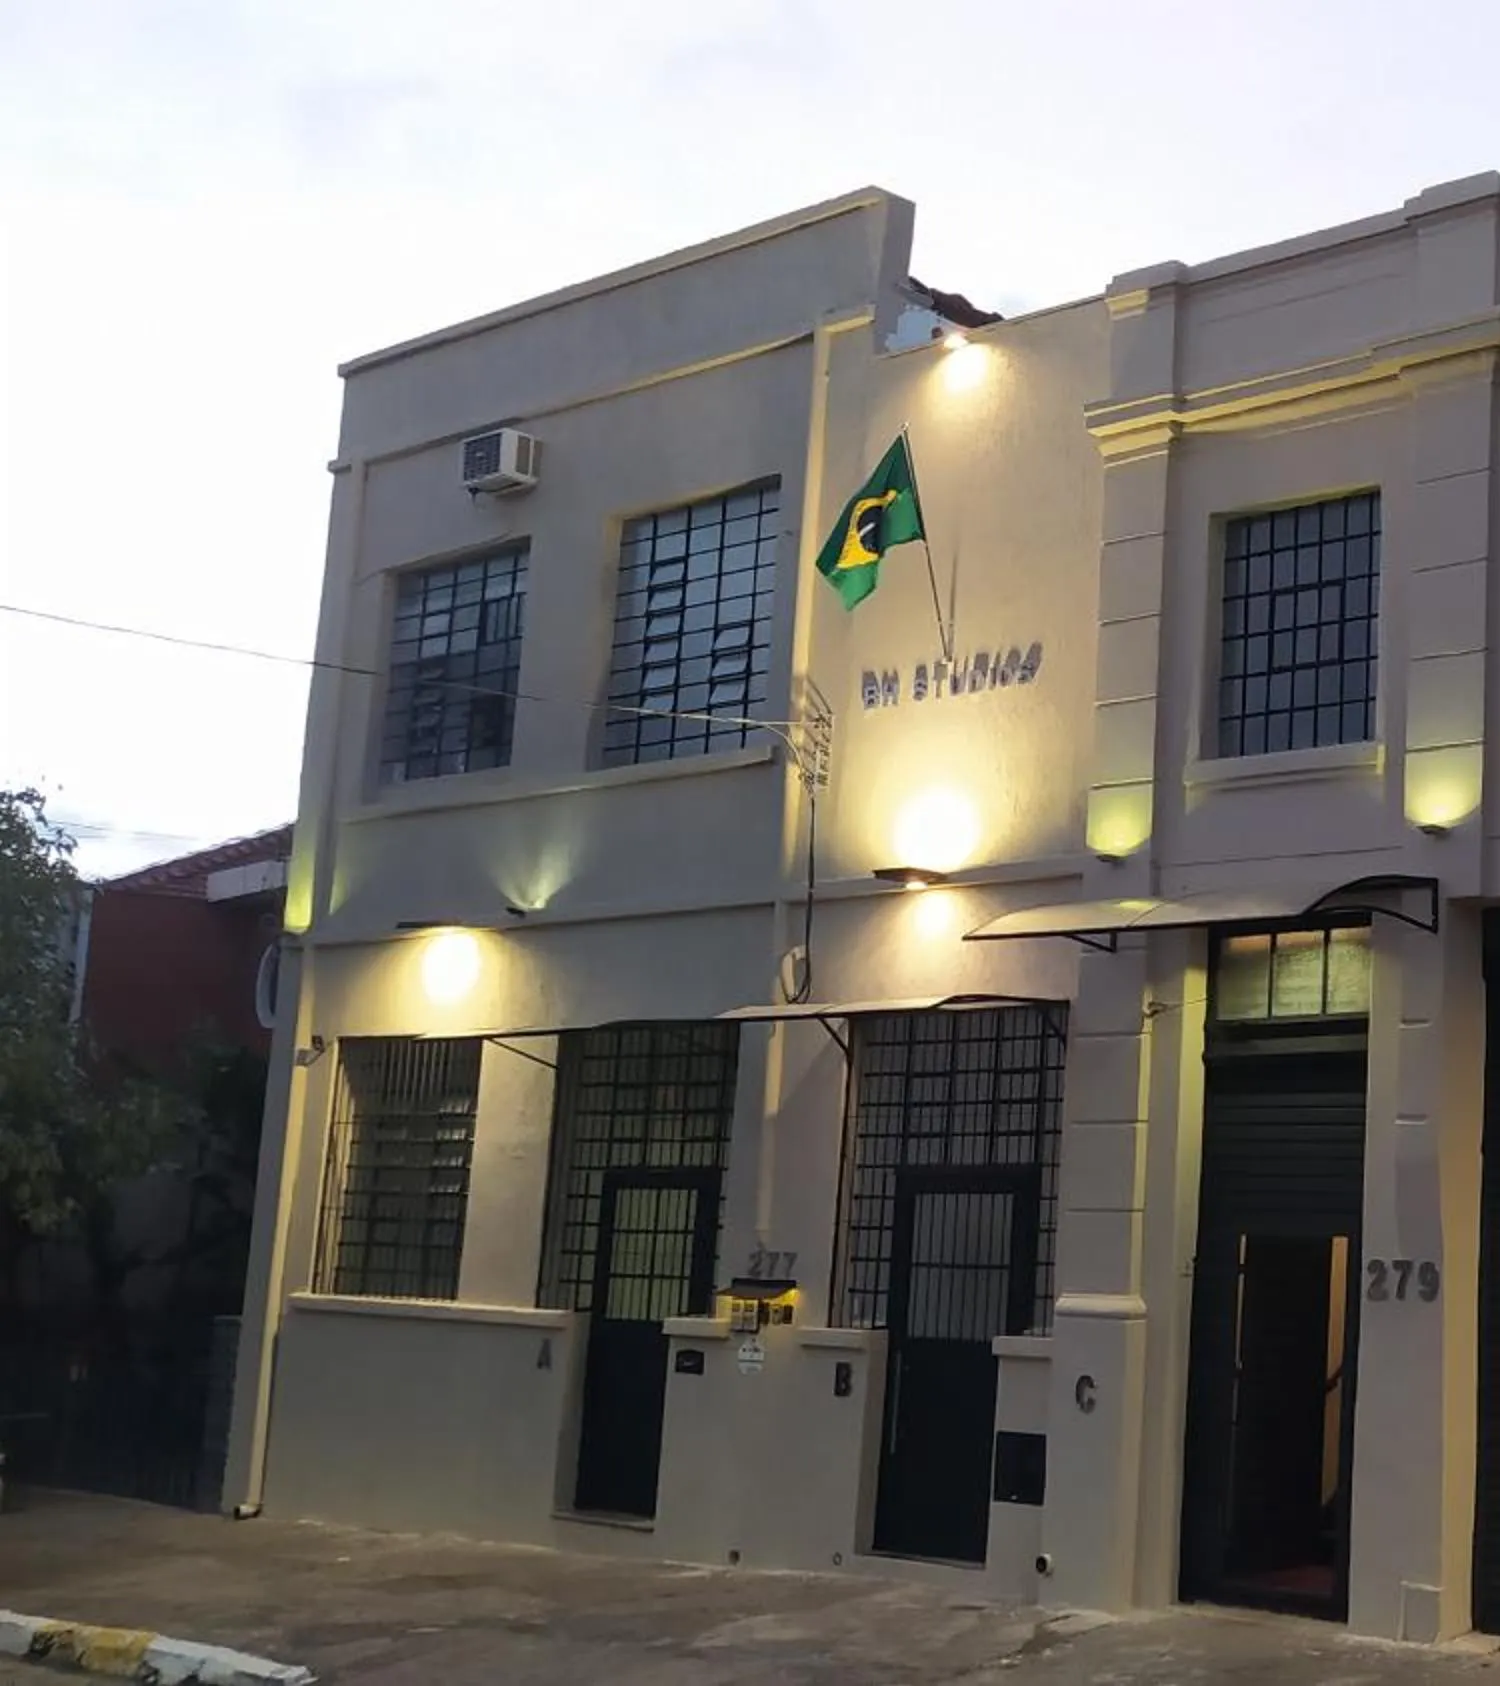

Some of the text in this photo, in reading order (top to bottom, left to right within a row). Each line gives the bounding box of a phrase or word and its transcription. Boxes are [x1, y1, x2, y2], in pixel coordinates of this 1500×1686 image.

[748, 1251, 797, 1279] 277
[1366, 1258, 1440, 1302] 279
[537, 1338, 552, 1372] A
[834, 1361, 852, 1397] B
[1075, 1374, 1097, 1414] C
